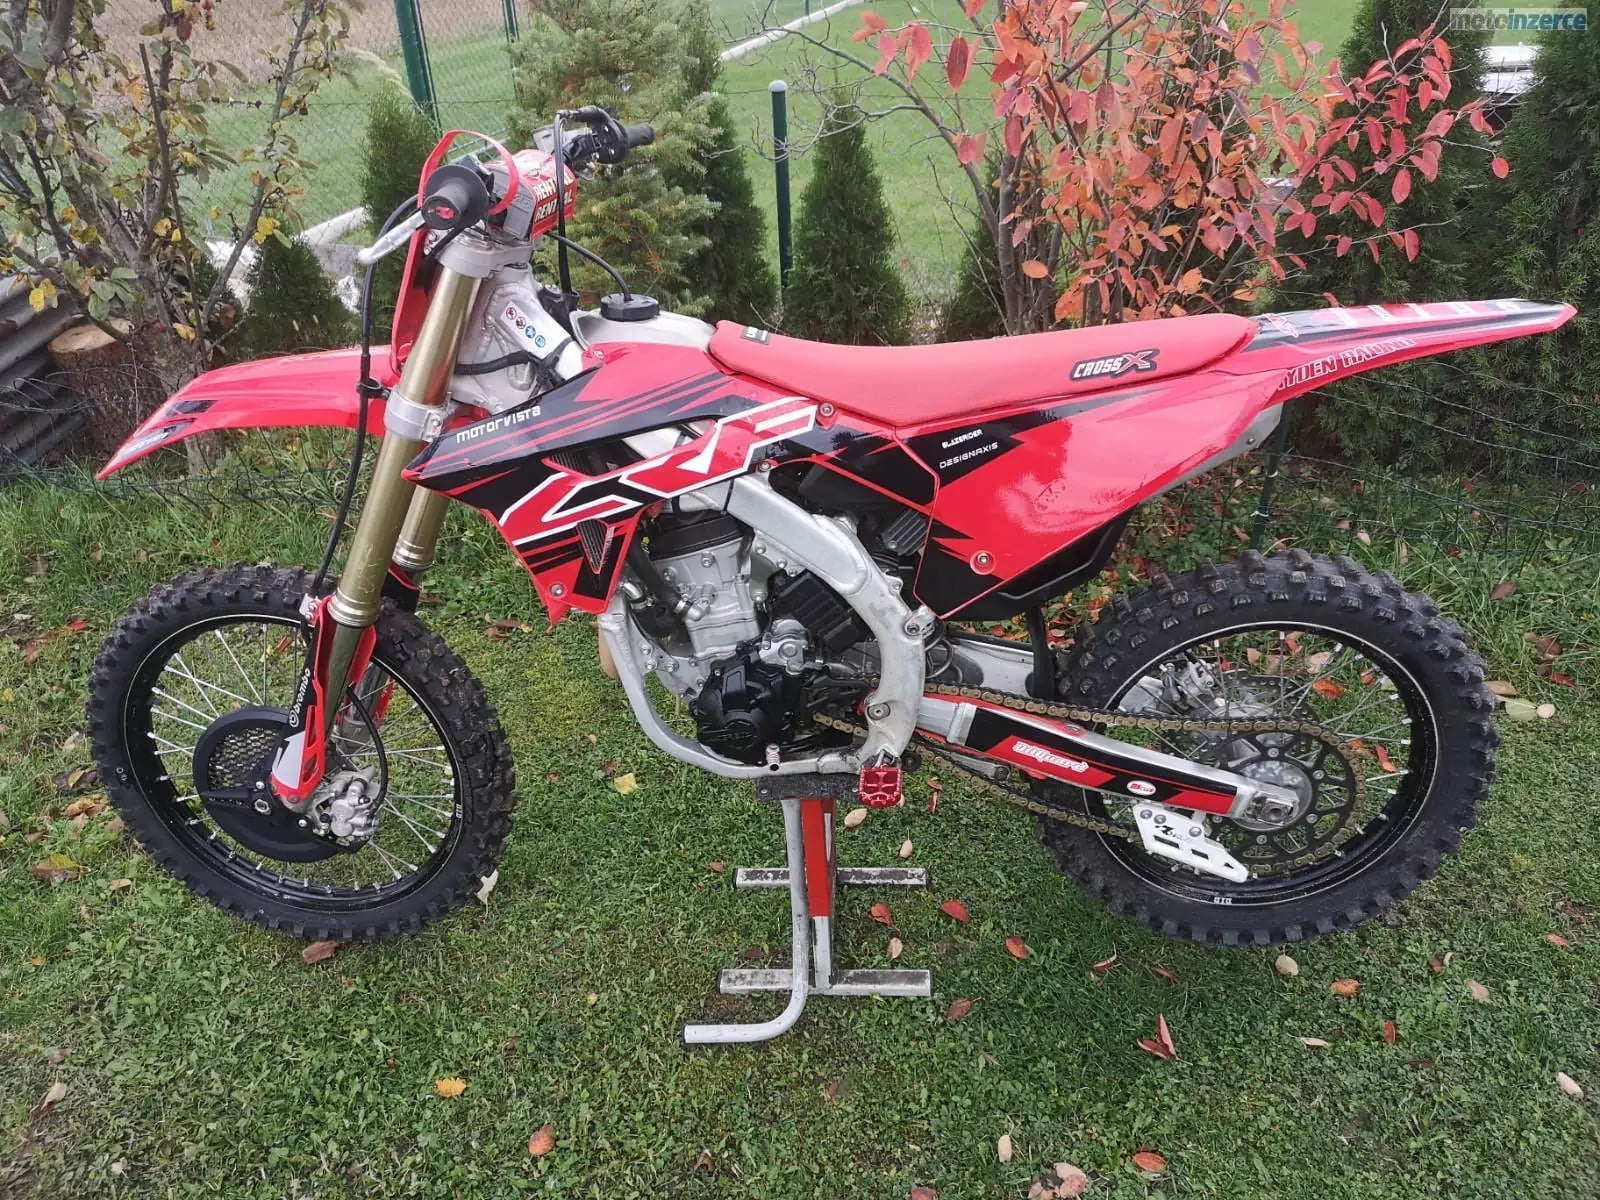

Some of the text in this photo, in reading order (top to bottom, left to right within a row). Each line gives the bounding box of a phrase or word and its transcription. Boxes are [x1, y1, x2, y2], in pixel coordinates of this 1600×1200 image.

[534, 173, 573, 202] RENTAL
[535, 191, 572, 222] RENTAL
[939, 442, 998, 469] DESIGNAXIS
[293, 667, 310, 714] brembo
